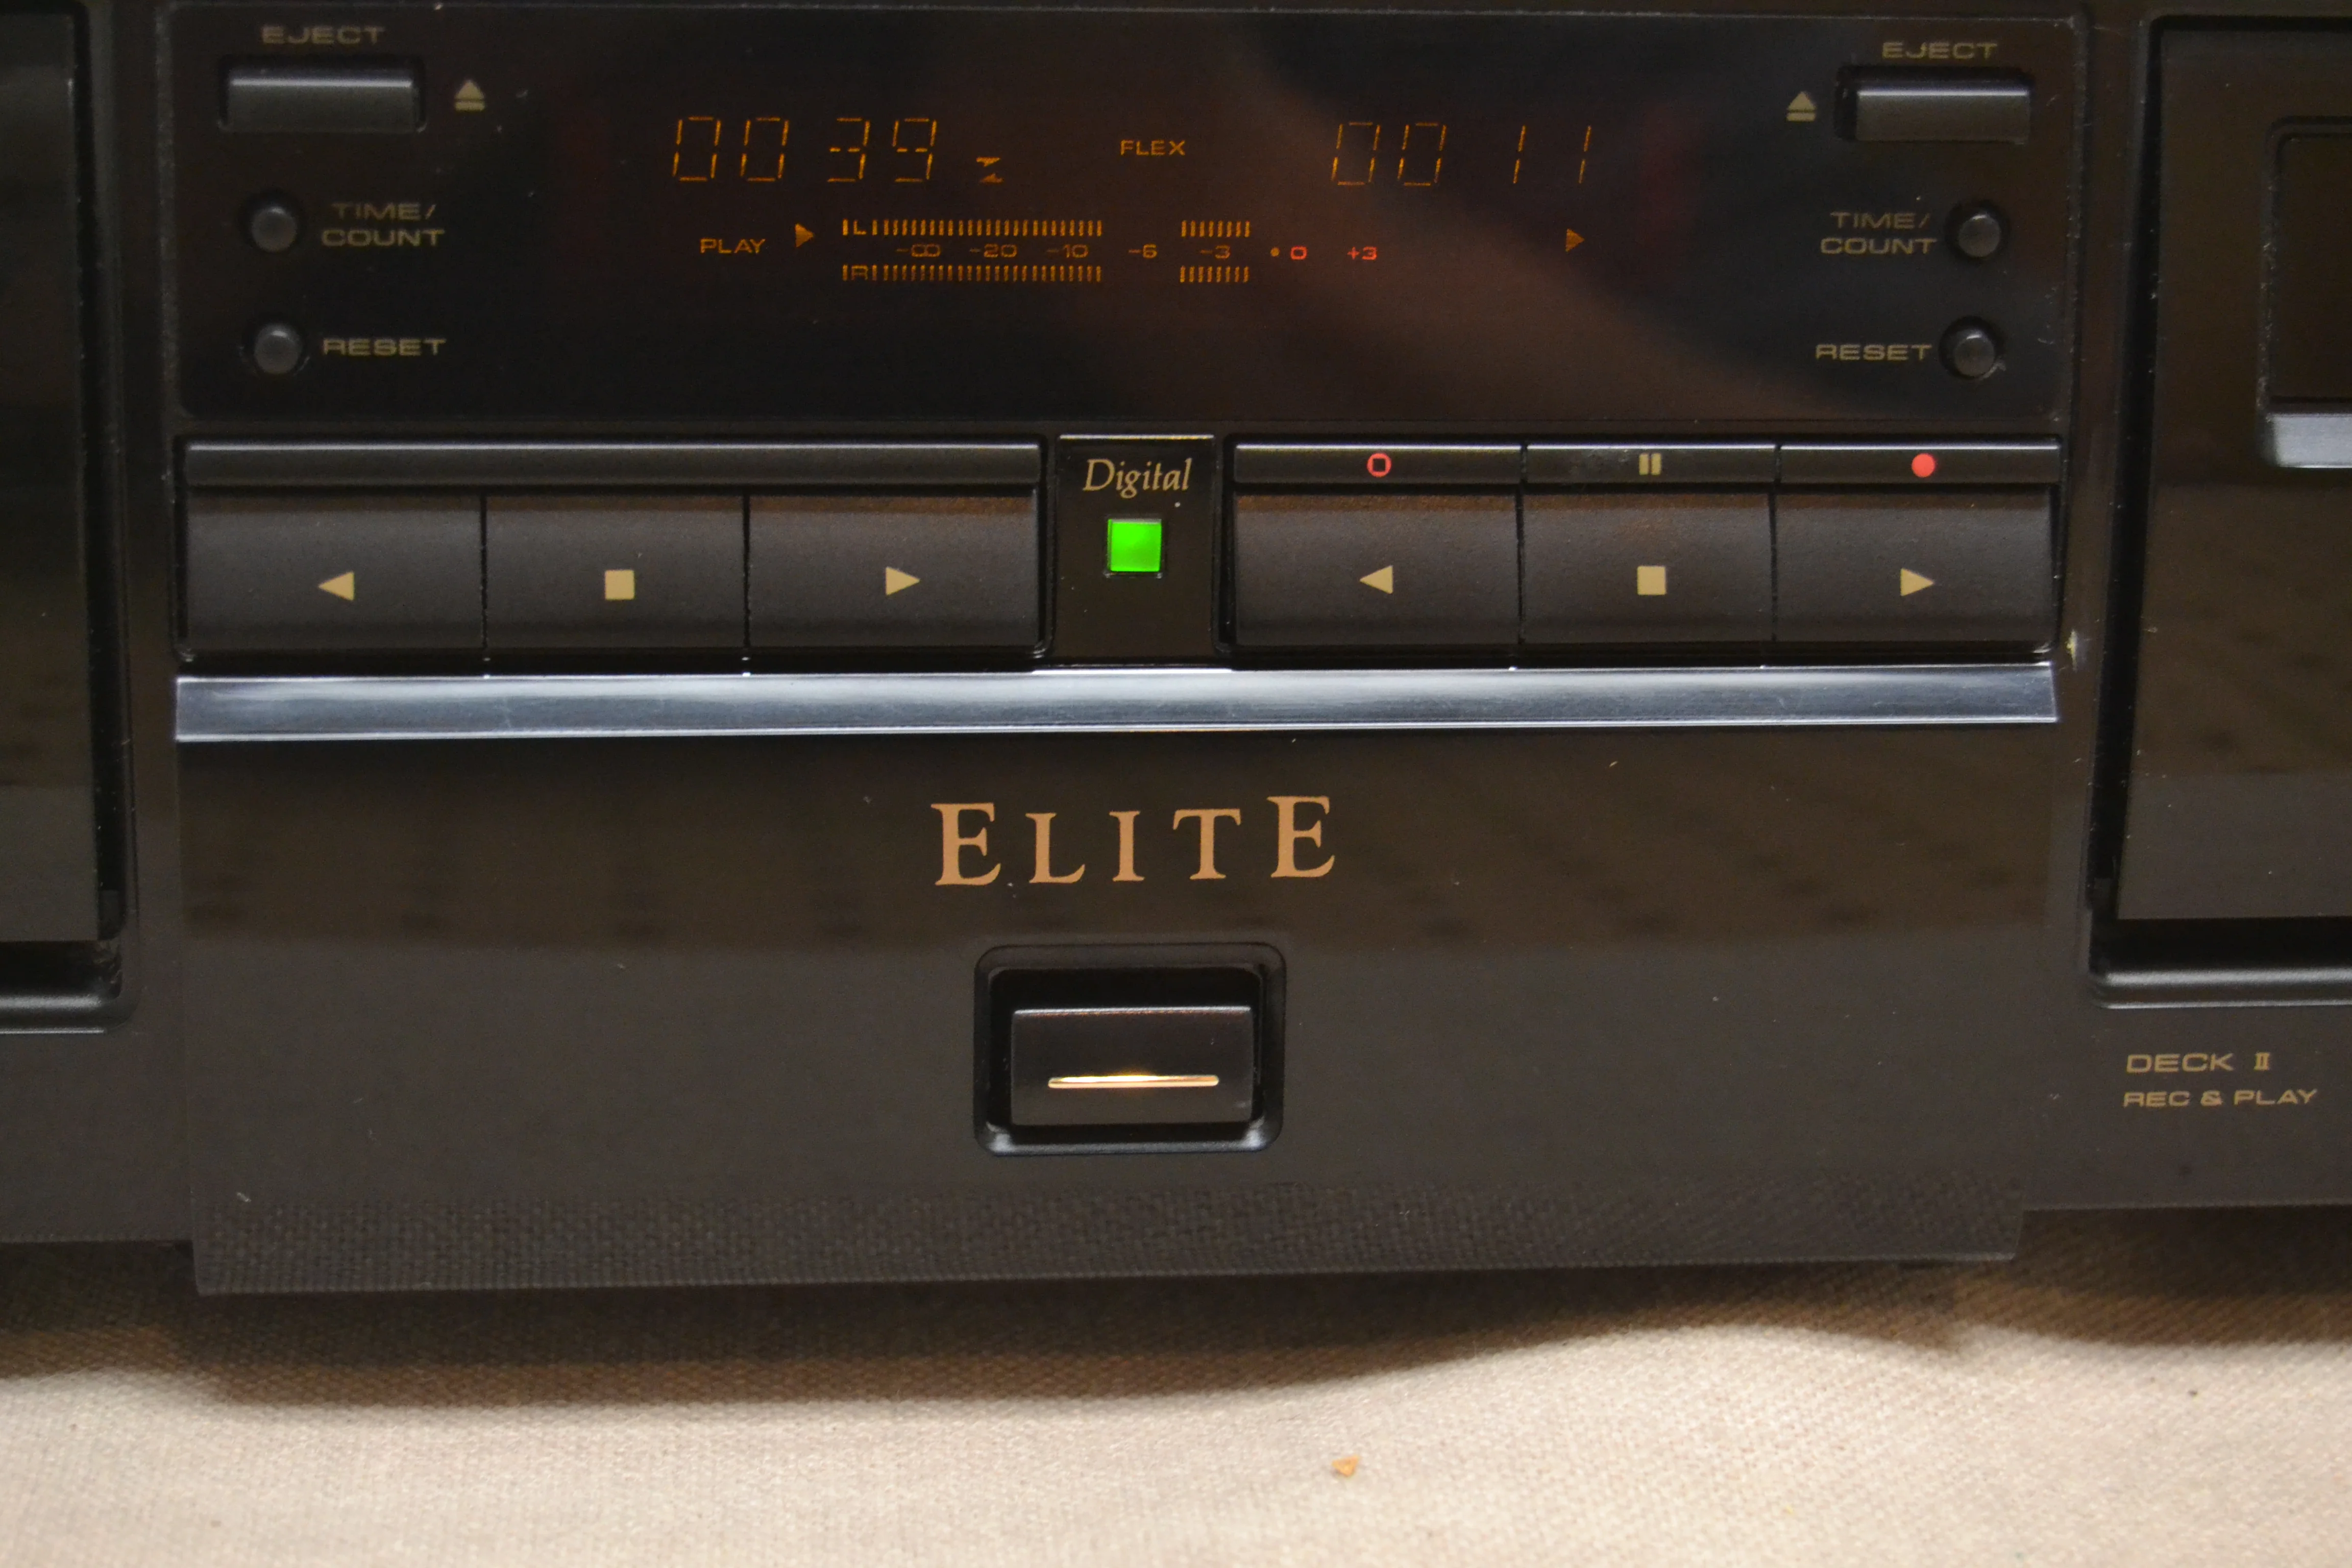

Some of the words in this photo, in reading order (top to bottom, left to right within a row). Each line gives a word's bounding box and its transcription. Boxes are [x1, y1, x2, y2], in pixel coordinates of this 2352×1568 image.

[262, 26, 385, 45] EJECT
[1881, 42, 1998, 59] EJECT
[1120, 140, 1186, 156] FLEX
[331, 203, 437, 221] TIME/
[1830, 212, 1931, 229] TIME/
[321, 229, 445, 247] COUNT
[699, 238, 766, 254] PLAY
[1821, 238, 1938, 255] COUNT
[1346, 246, 1378, 260] +3
[322, 337, 447, 356] RESET
[1815, 344, 1933, 361] RESET
[1082, 457, 1193, 499] Digital
[930, 795, 1336, 887] ELITE
[2126, 1052, 2234, 1073] DECK
[2123, 1091, 2191, 1108] REC
[2200, 1090, 2223, 1107] &
[2234, 1088, 2318, 1106] PLAY
